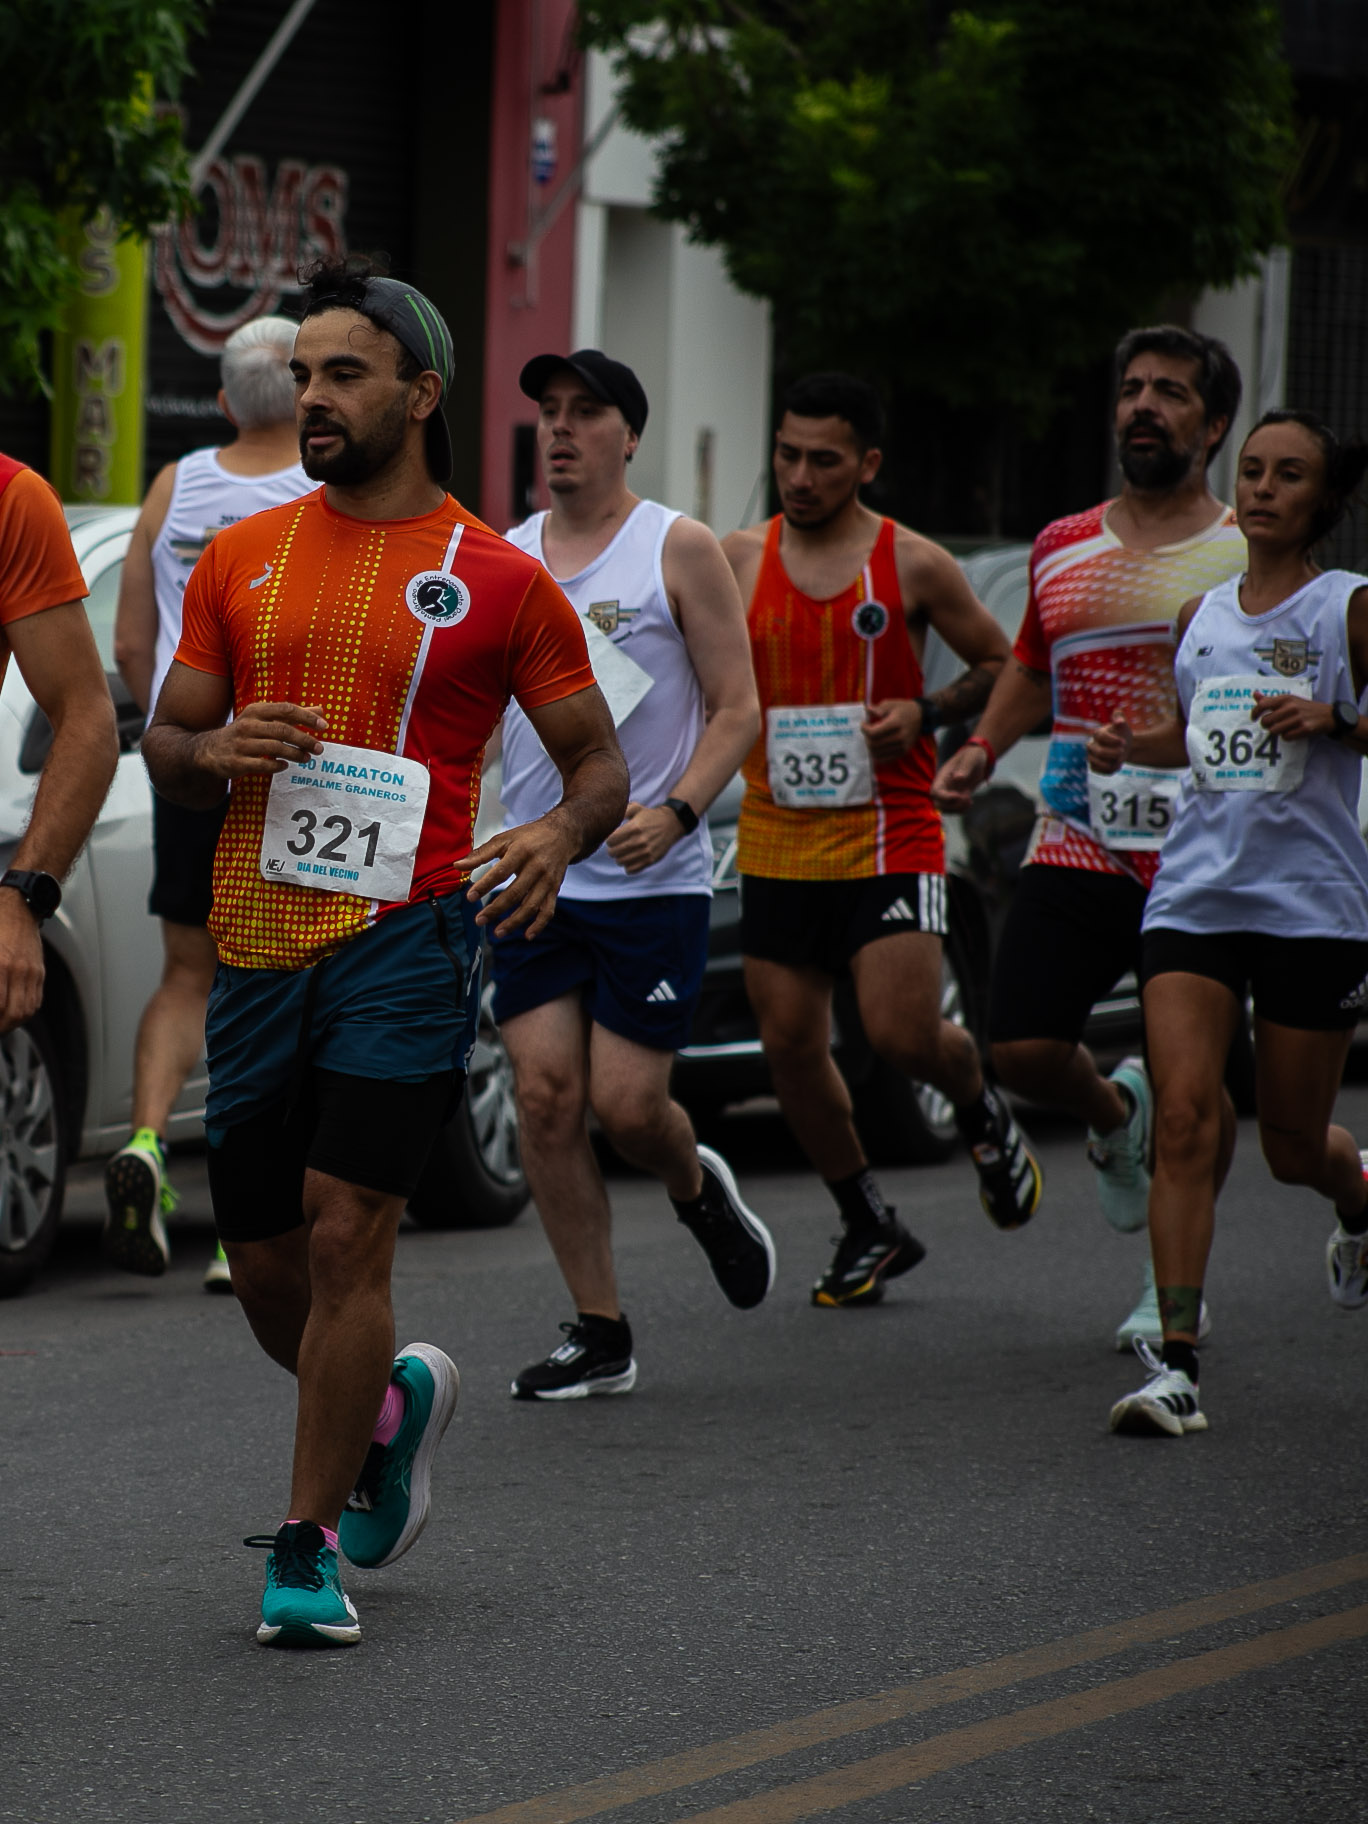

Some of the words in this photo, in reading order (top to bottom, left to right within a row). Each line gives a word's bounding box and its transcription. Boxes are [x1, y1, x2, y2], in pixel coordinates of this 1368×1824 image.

[72, 334, 127, 501] MAR
[1224, 687, 1292, 699] MARTON
[1204, 728, 1282, 767] 364
[320, 760, 405, 787] MARATON
[783, 751, 849, 786] 335
[290, 775, 343, 792] EMPALME
[344, 785, 407, 803] GRANEROS
[1100, 791, 1170, 830] 315
[286, 809, 382, 868] 321
[296, 861, 311, 873] DIA
[312, 863, 328, 876] DEL
[329, 866, 360, 882] VECINO
